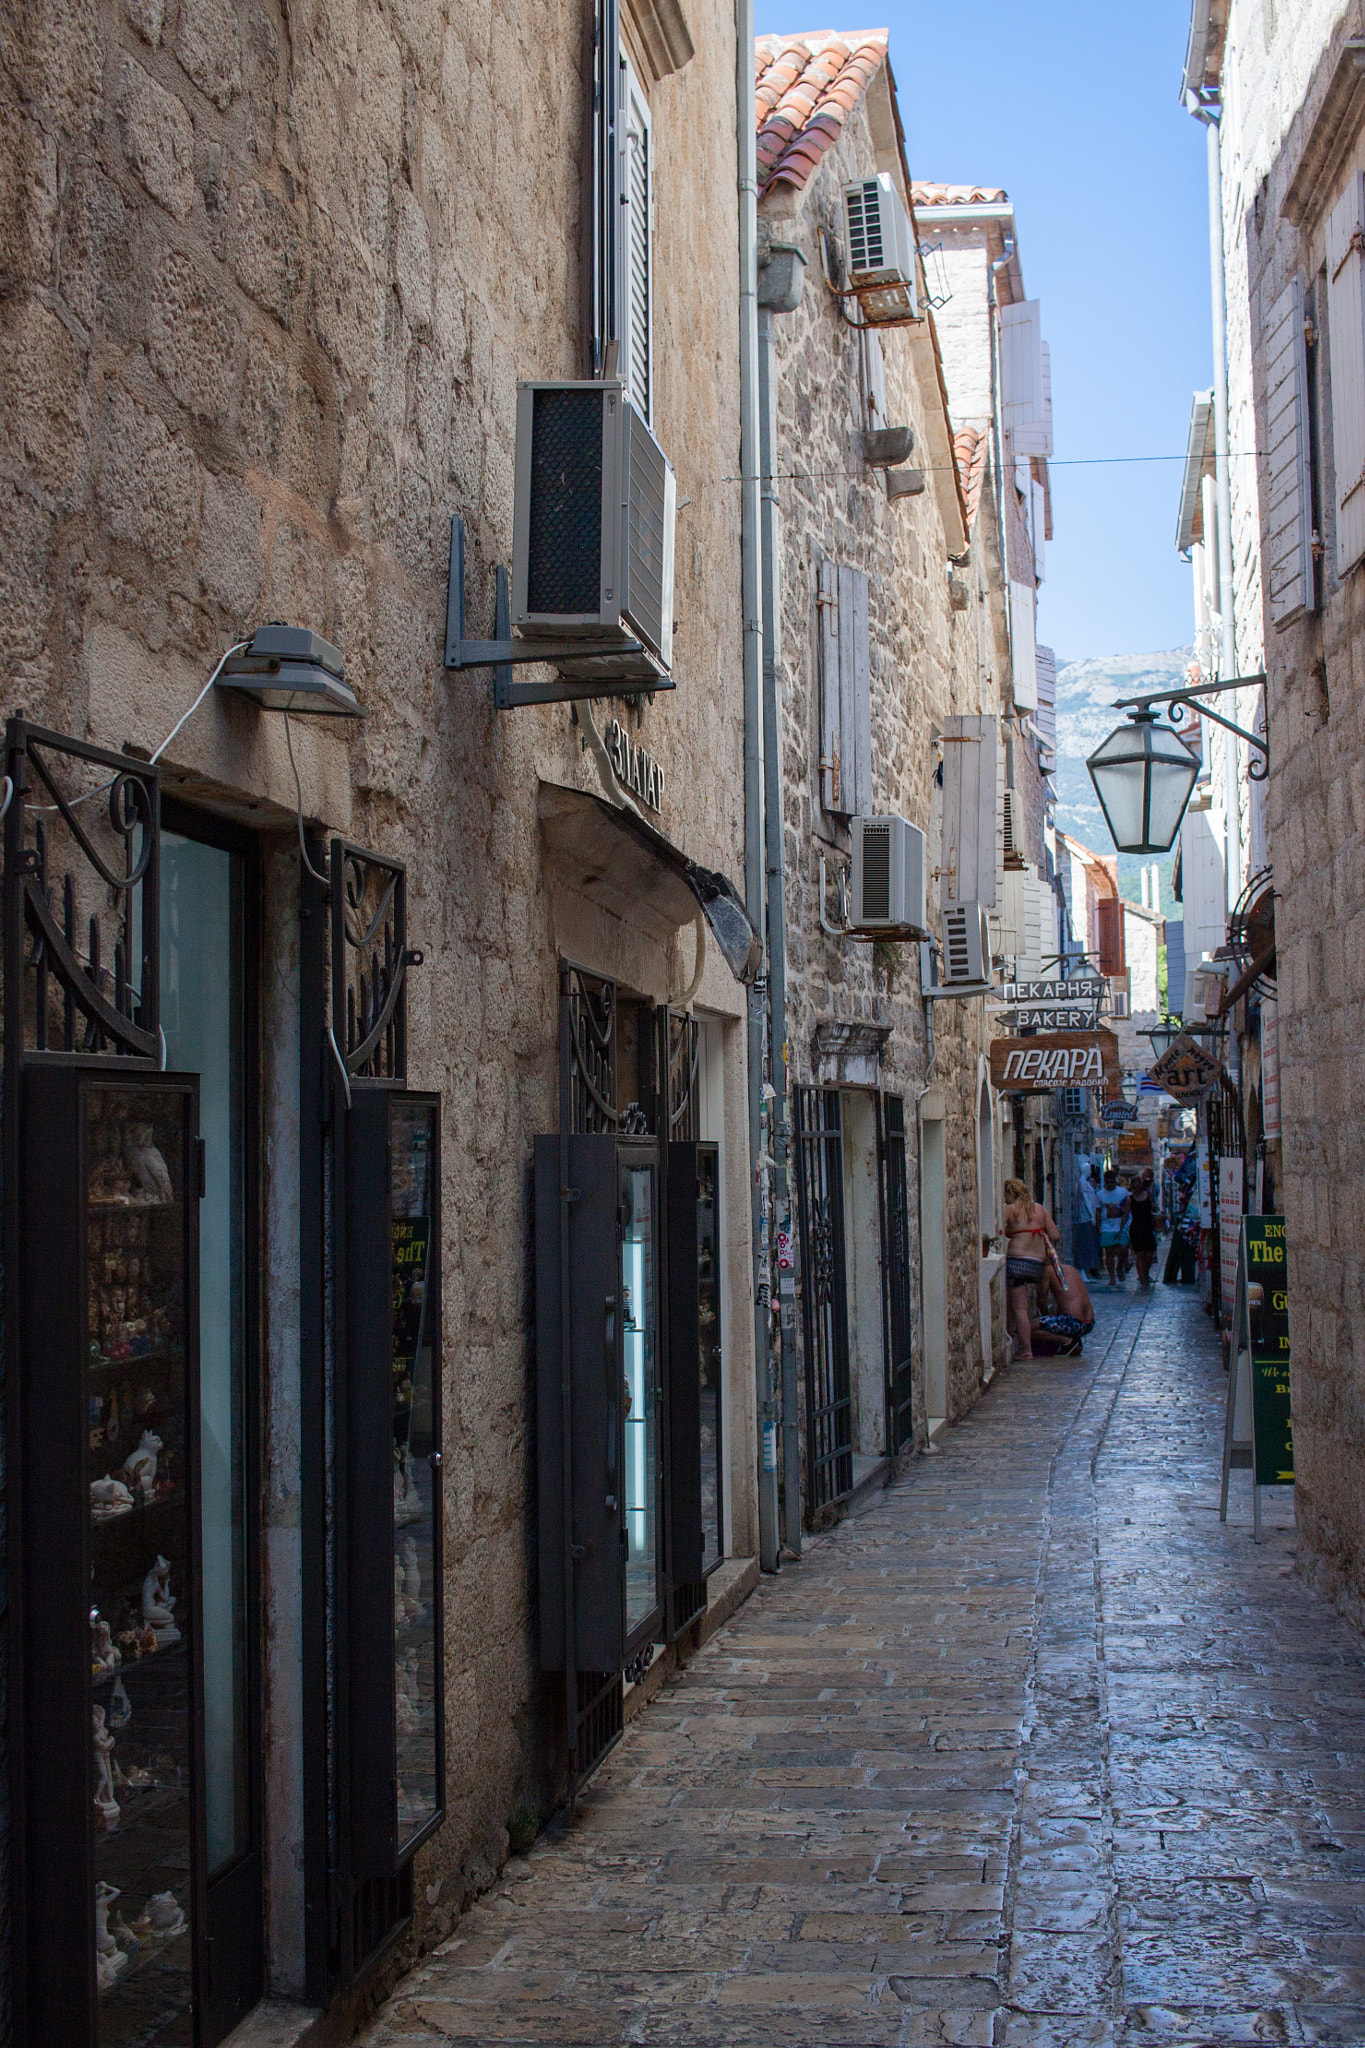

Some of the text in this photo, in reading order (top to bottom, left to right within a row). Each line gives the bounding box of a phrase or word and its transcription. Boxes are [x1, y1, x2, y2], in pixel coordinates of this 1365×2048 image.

[1003, 981, 1093, 999] ПЕКАРНЯ
[1017, 1010, 1093, 1028] BAKERY
[1167, 1068, 1208, 1087] art
[1249, 1240, 1284, 1263] The
